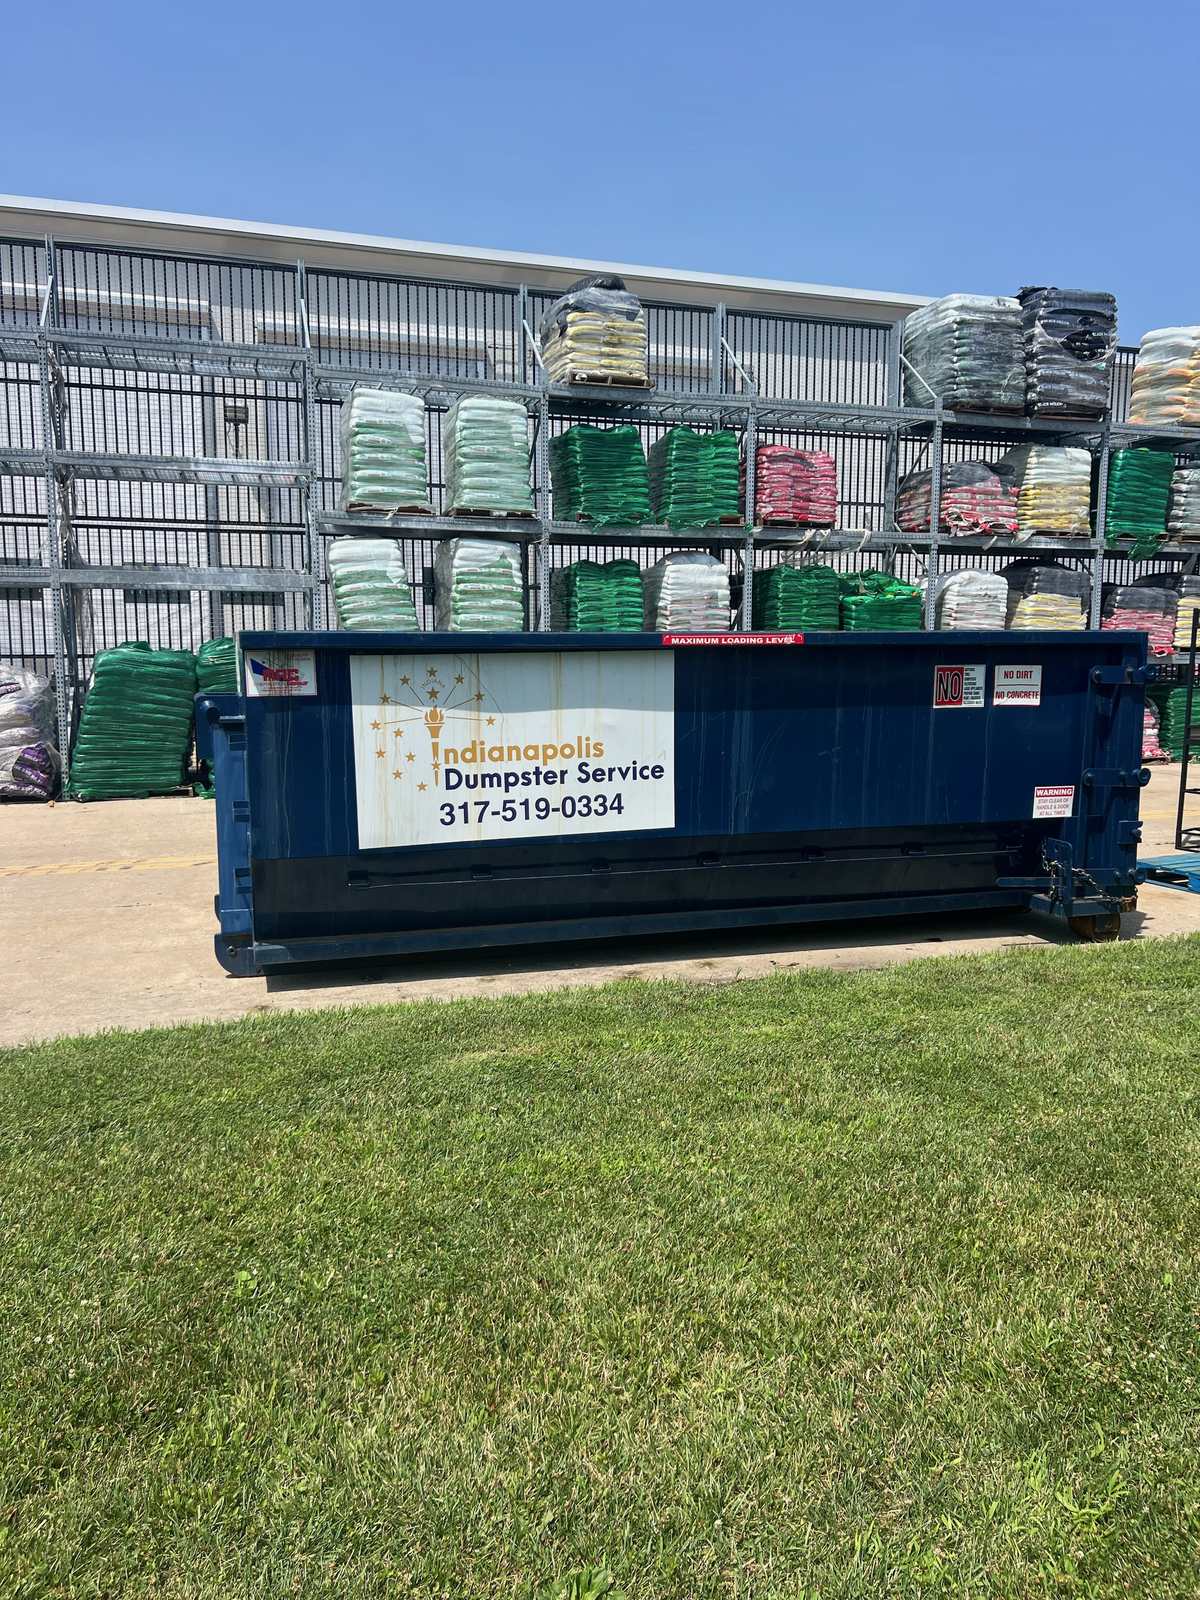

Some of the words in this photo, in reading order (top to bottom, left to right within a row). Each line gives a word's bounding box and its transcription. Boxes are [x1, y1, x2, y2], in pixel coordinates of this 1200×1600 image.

[671, 637, 719, 645] MAXIMUM
[721, 637, 765, 645] LOADING
[1003, 670, 1013, 680] NO
[1016, 670, 1034, 680] DIRT
[935, 670, 964, 702] NO
[995, 690, 1005, 700] NO
[1006, 690, 1040, 700] CONCRETE
[444, 765, 568, 793] Dumpster
[576, 760, 665, 784] Service
[1036, 788, 1072, 797] WARNING
[439, 793, 624, 826] 317-519-0334
